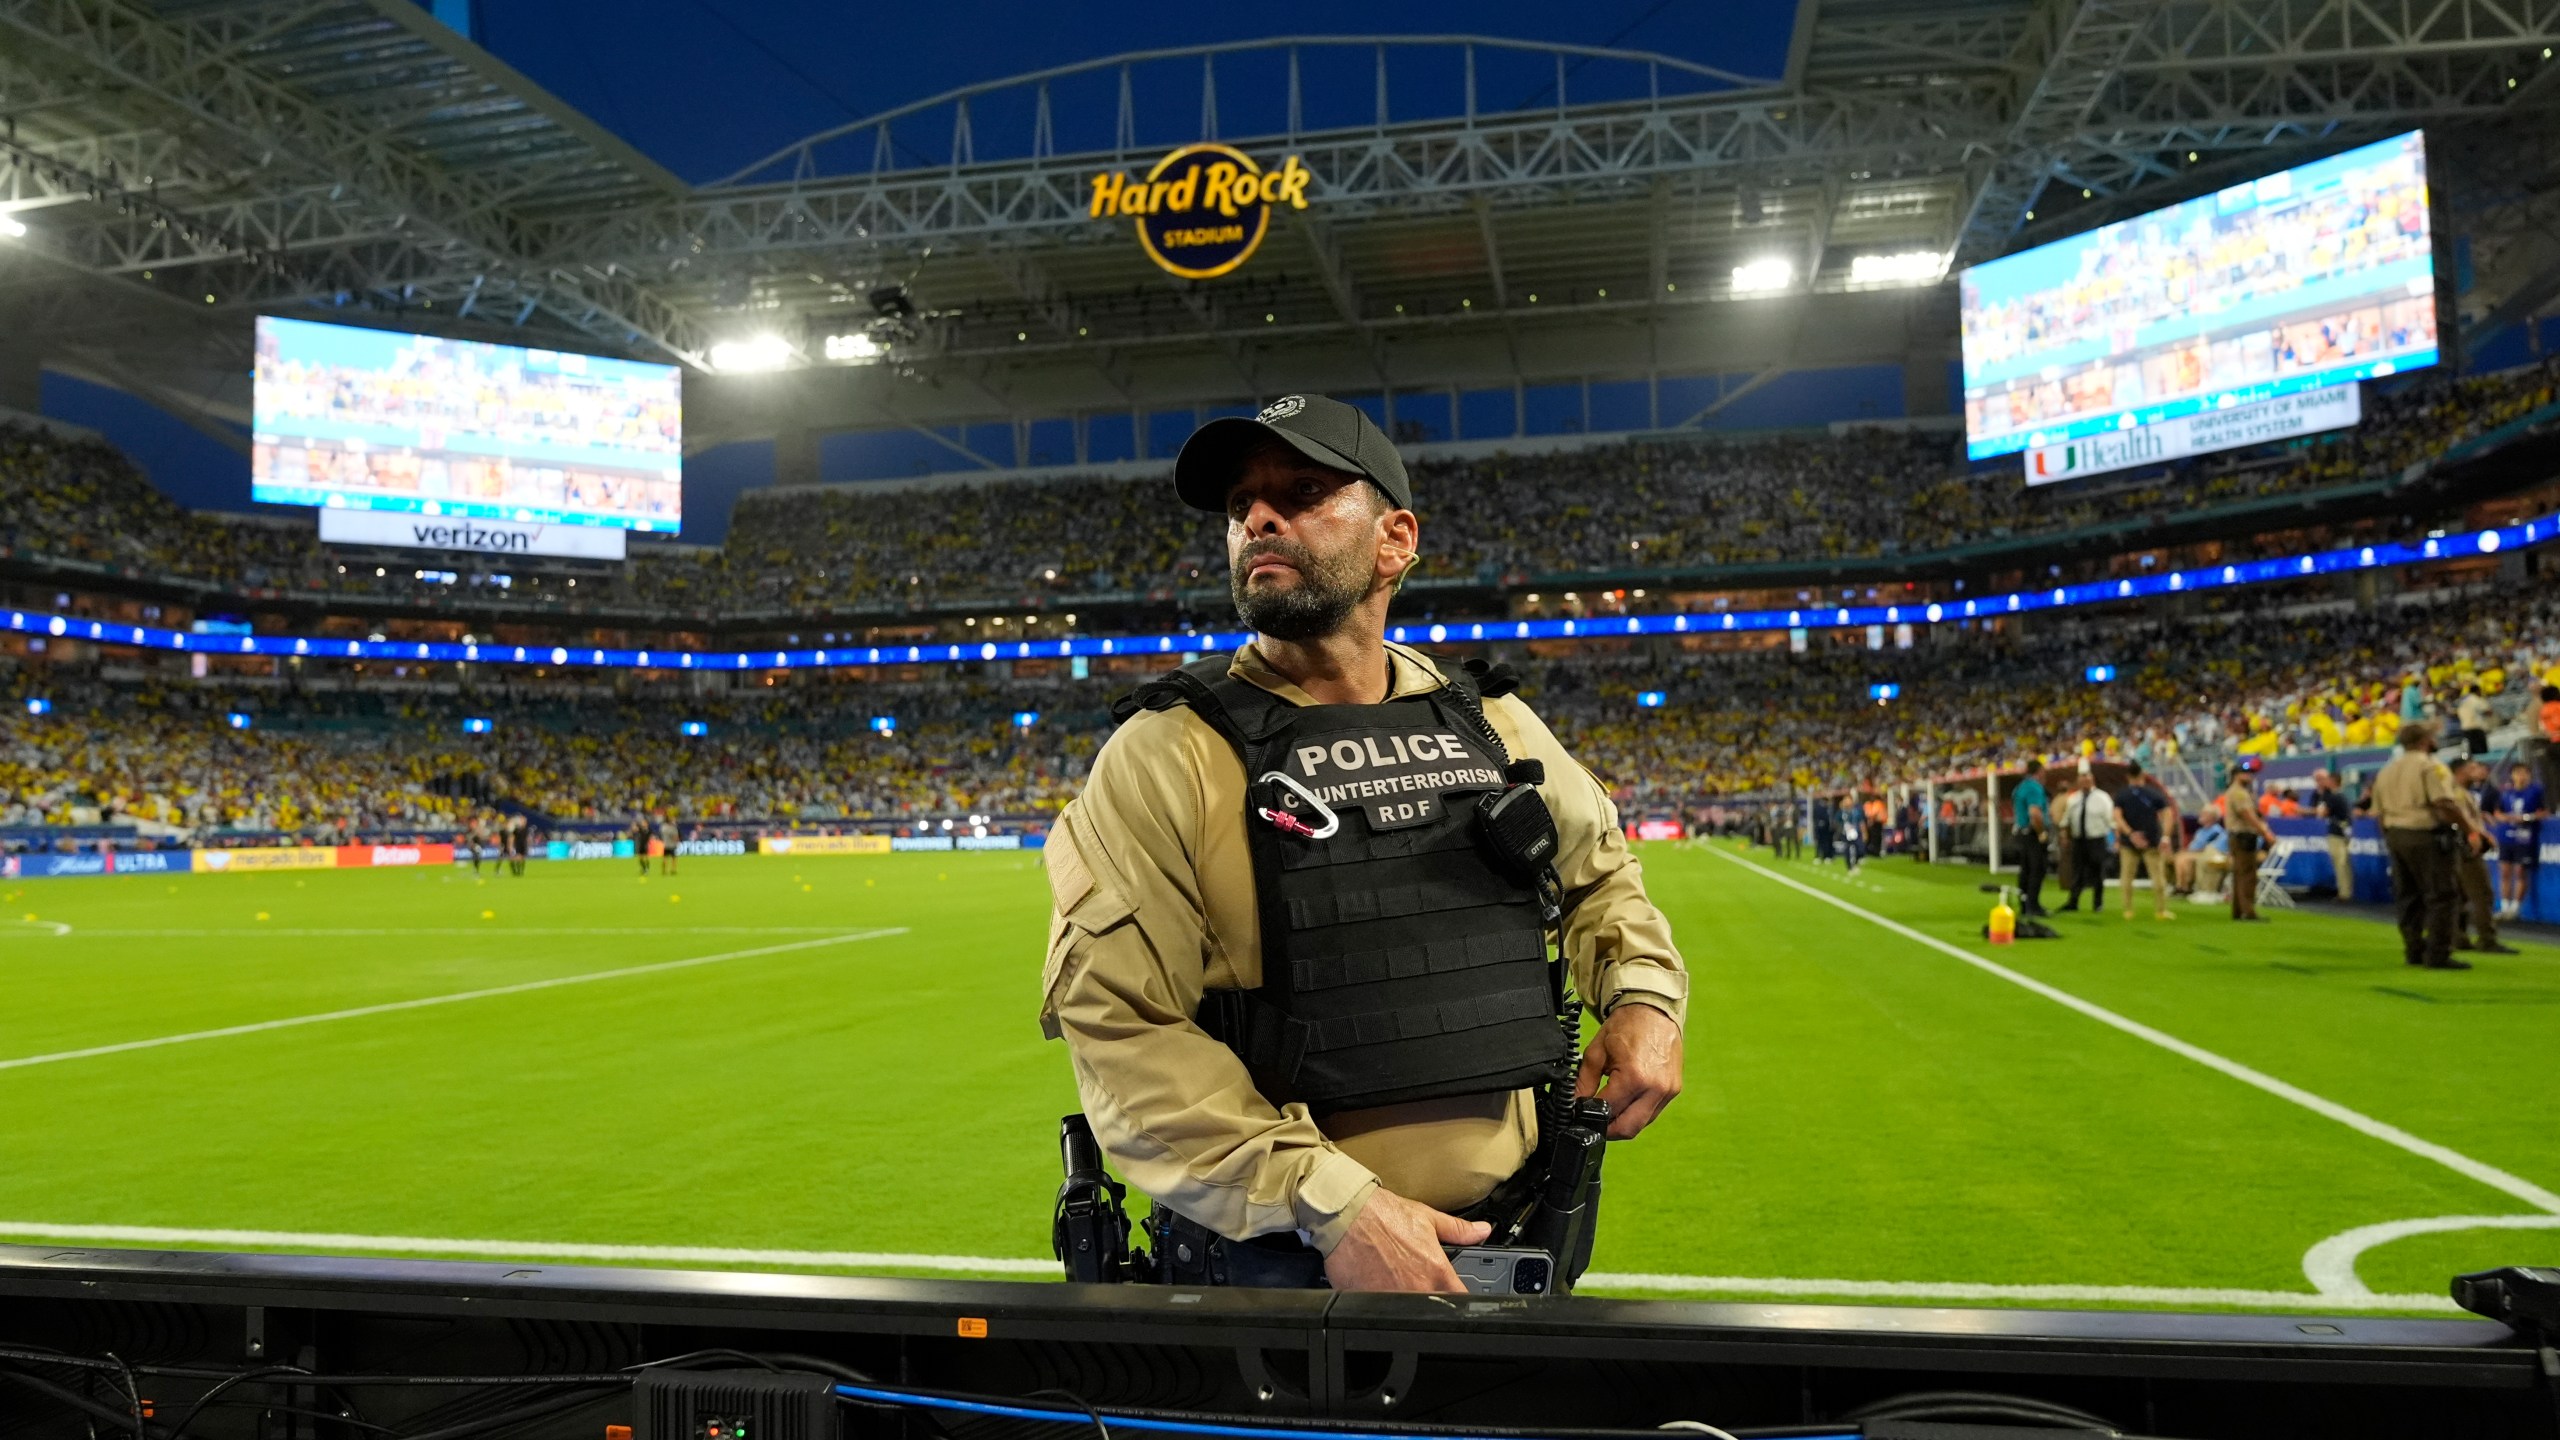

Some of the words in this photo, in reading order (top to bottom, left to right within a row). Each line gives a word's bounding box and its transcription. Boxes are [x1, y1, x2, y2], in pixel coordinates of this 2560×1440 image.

[1090, 163, 1201, 218] Hard
[1203, 155, 1311, 218] Rock
[1163, 225, 1244, 249] STADIUM
[2189, 406, 2270, 430] UNIVERSITY
[2274, 401, 2292, 415] OF
[2296, 388, 2348, 410] MIAMI
[2190, 428, 2244, 449] HEALTH
[2248, 415, 2304, 438] SYSTEM
[413, 521, 529, 549] verizon
[1296, 734, 1470, 777] POLICE
[1283, 768, 1503, 809] CUNTERTERRORISM
[236, 850, 295, 867] mercado
[675, 839, 745, 856] priceless
[1531, 838, 1547, 855] OTTO
[115, 853, 168, 872] ULTRA
